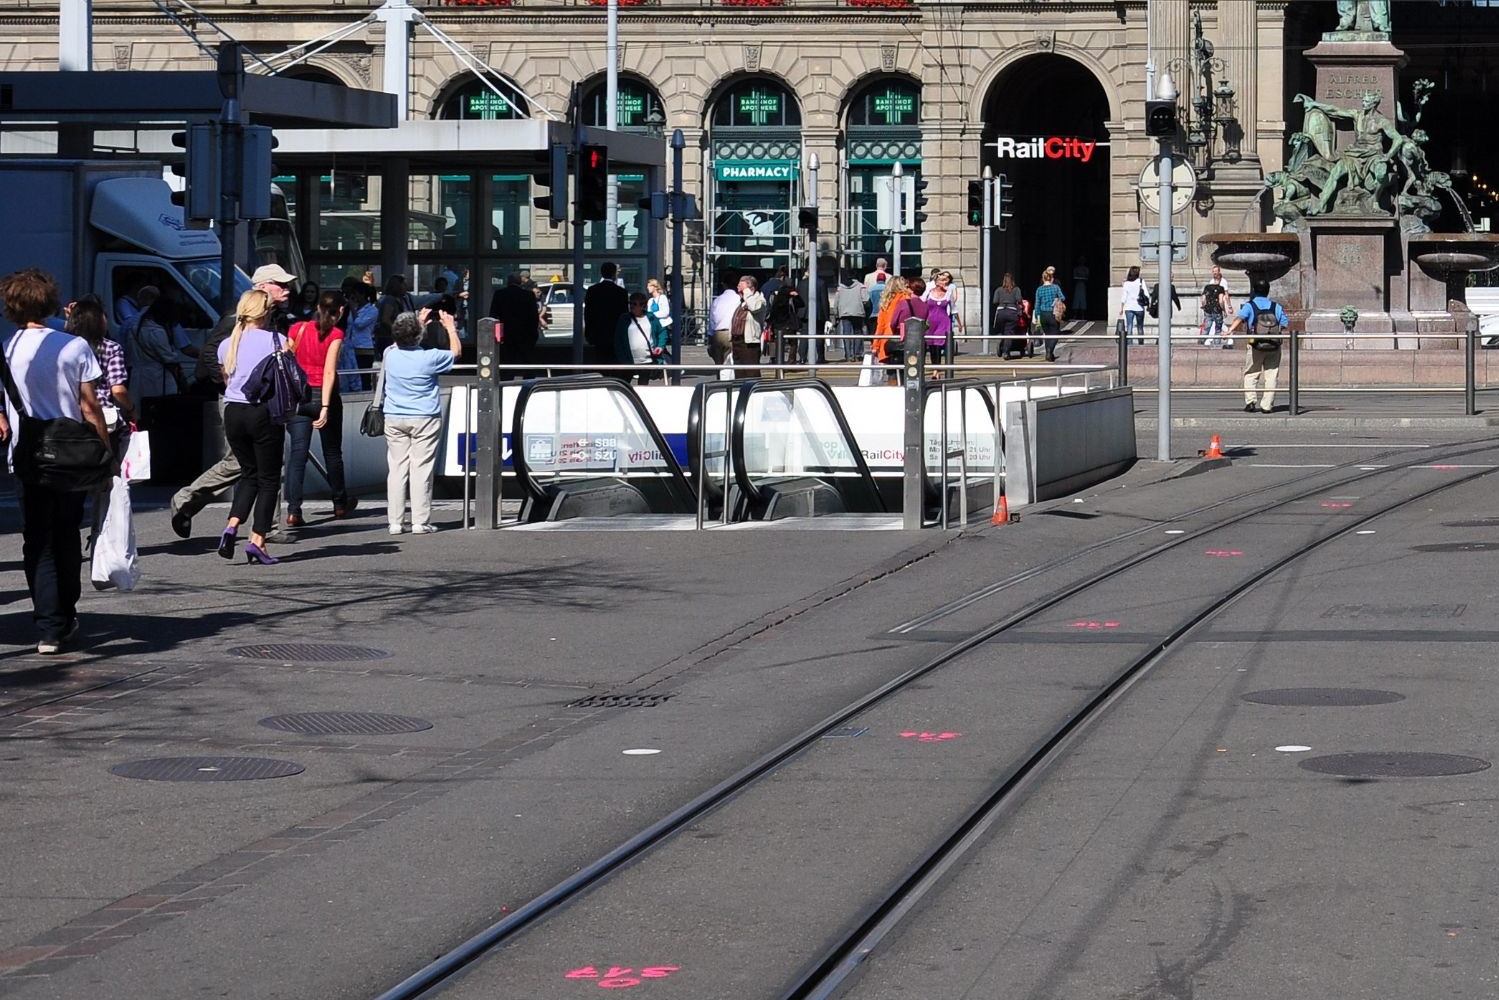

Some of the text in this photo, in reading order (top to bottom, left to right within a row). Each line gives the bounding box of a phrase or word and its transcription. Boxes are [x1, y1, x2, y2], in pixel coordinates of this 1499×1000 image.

[1329, 74, 1378, 85] ALFRED
[997, 137, 1095, 162] RailCity
[723, 166, 789, 178] PHARMACY
